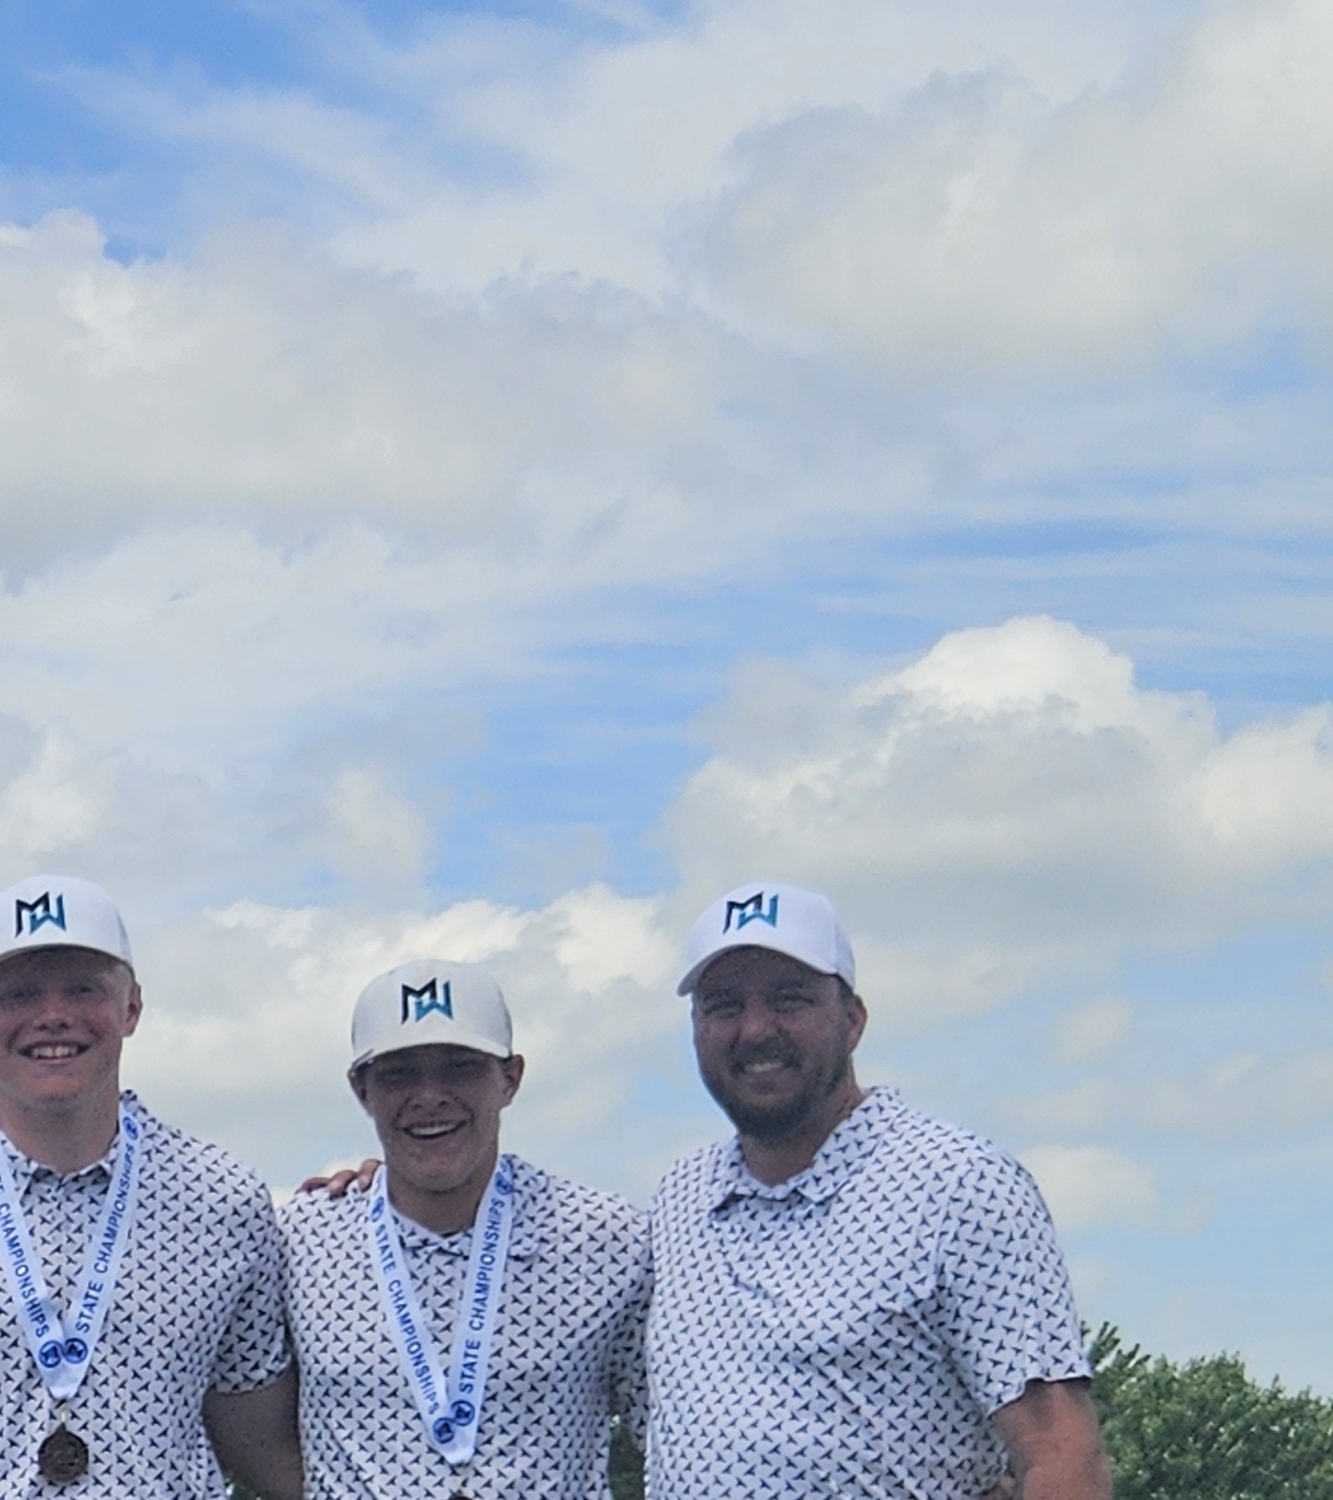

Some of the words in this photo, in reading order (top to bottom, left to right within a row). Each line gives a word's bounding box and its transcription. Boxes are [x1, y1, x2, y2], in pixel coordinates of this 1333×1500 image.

[75, 1280, 103, 1333] STATE
[94, 1143, 135, 1274] CHAMPIONSHIPS
[373, 1223, 397, 1275] STATE
[388, 1279, 440, 1415] CHAMPIONSHIPS
[469, 1197, 506, 1332] CHAMPIONSHIPS
[459, 1338, 481, 1395] STATE
